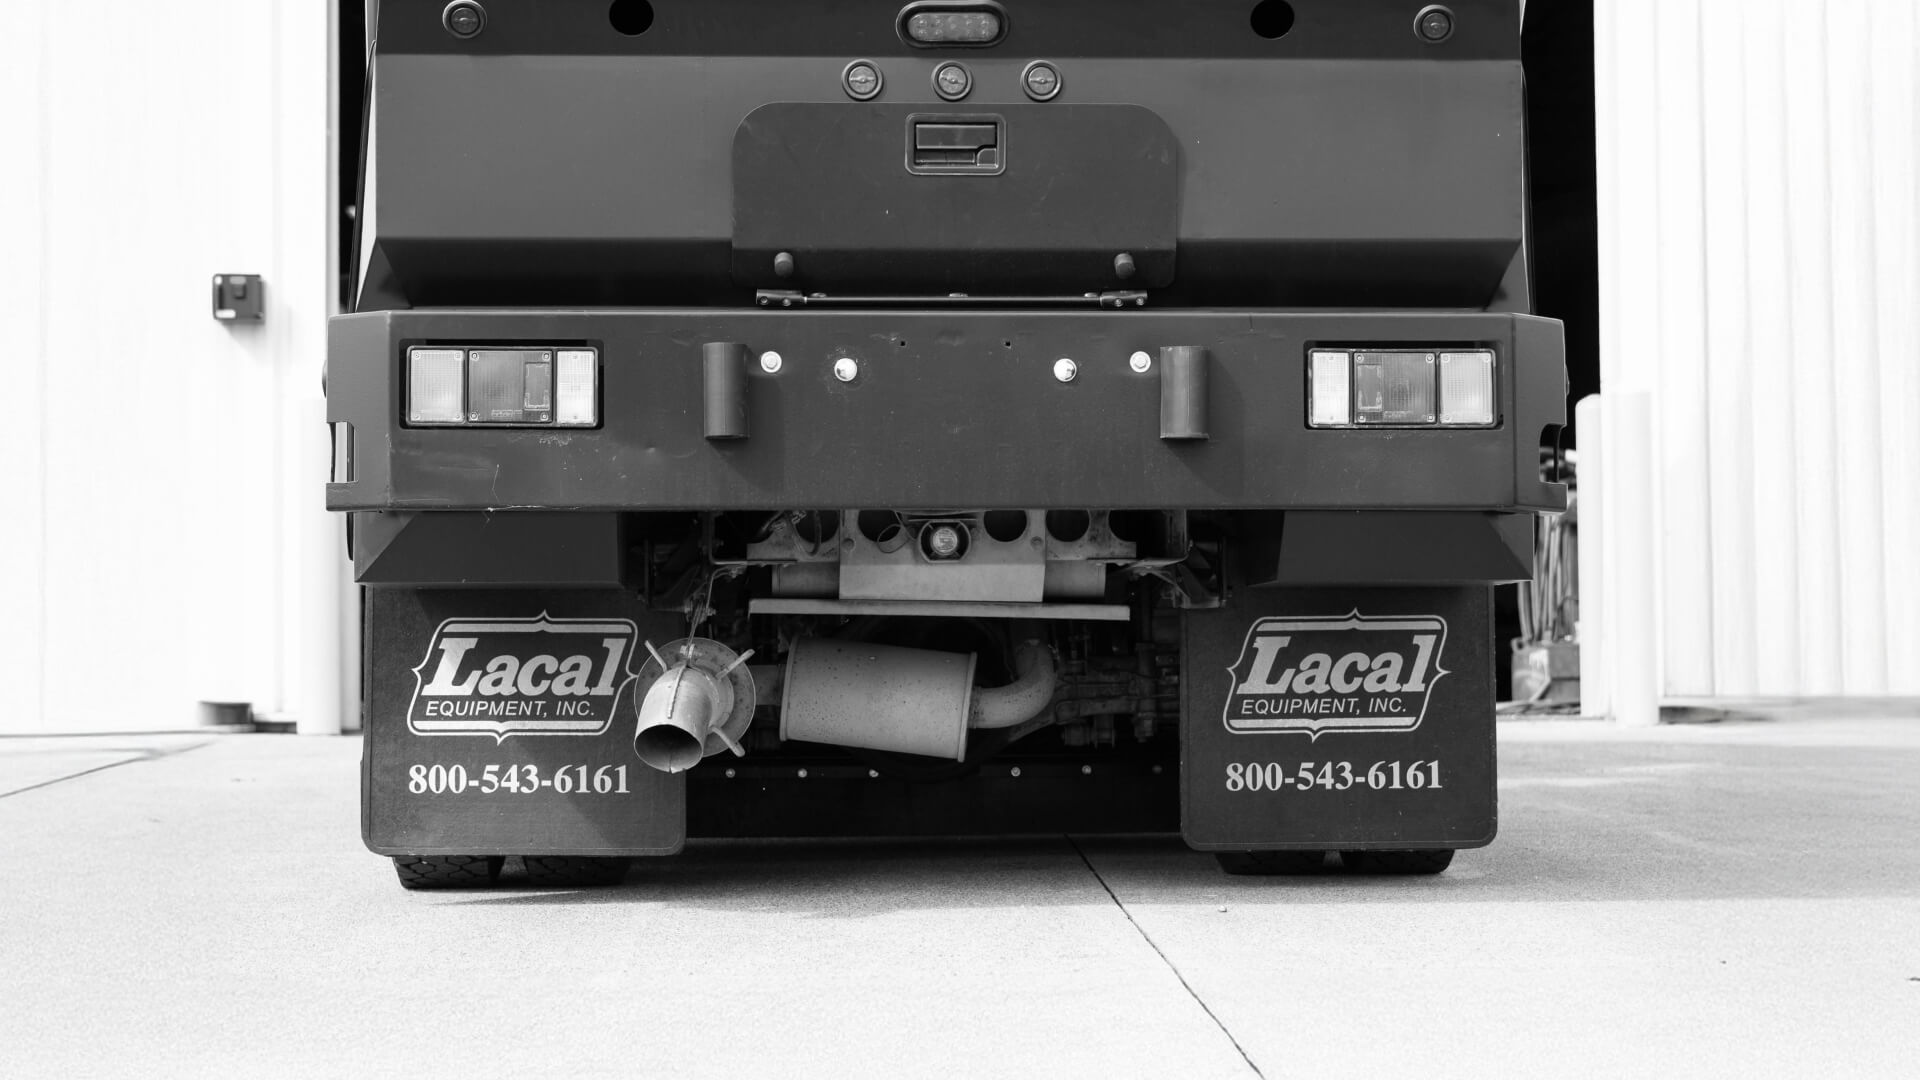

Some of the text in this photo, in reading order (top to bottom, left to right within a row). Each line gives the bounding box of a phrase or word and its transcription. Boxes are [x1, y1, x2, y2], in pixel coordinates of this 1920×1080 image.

[421, 637, 627, 696] Lacal
[1236, 634, 1437, 694] Lacal
[425, 701, 595, 718] EQUIPMENT, INC.
[1241, 697, 1406, 715] EQUIPMENT, INC.
[408, 764, 630, 793] 800-543-6161
[1225, 760, 1443, 791] 800-543-6161
